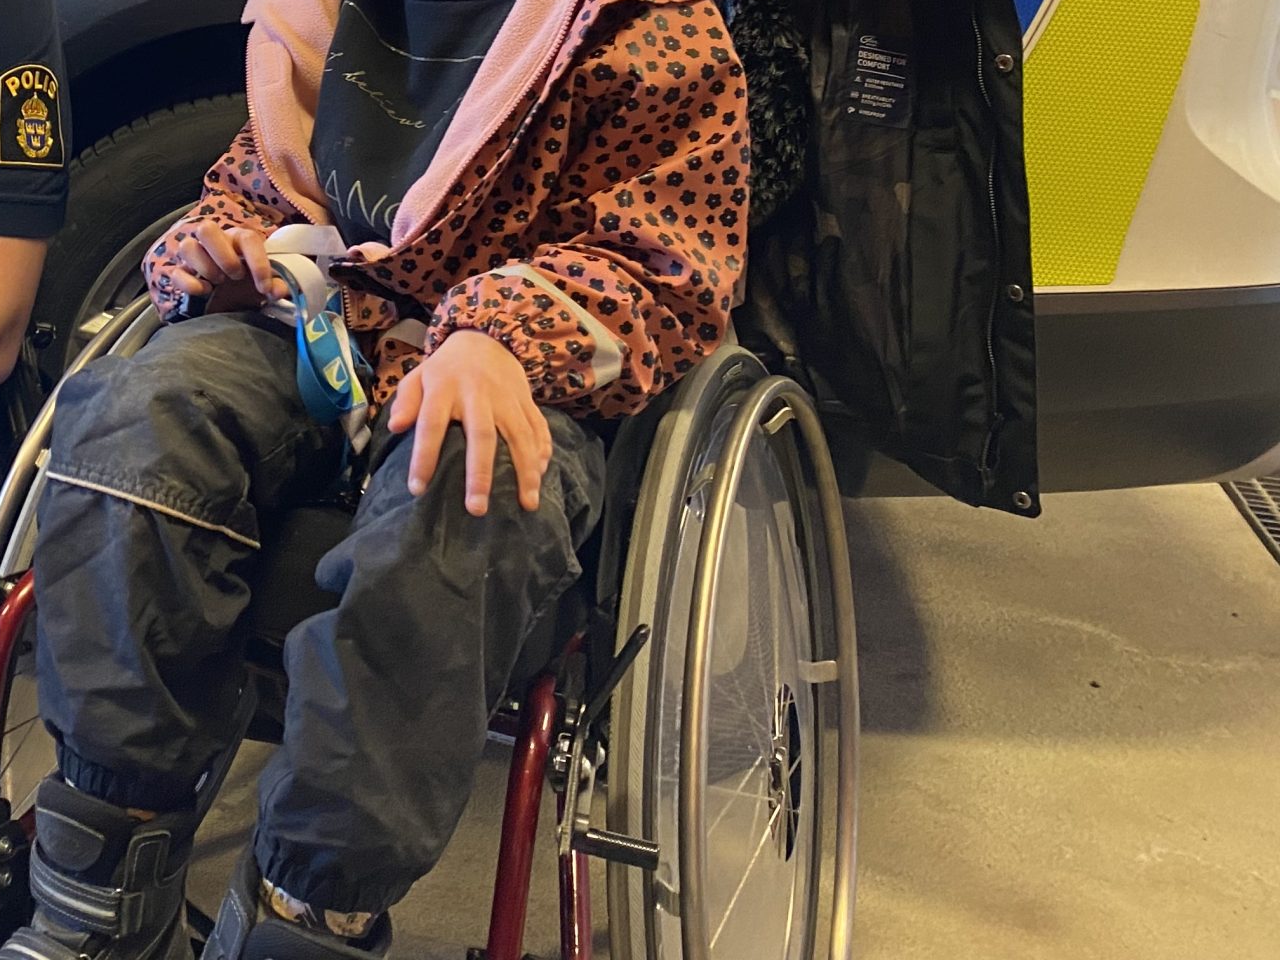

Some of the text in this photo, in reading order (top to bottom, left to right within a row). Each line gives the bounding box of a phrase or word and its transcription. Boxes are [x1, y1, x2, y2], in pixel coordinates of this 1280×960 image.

[857, 58, 892, 71] COMFORT
[858, 50, 907, 66] DESIGNED FOR
[5, 69, 58, 100] POLIS
